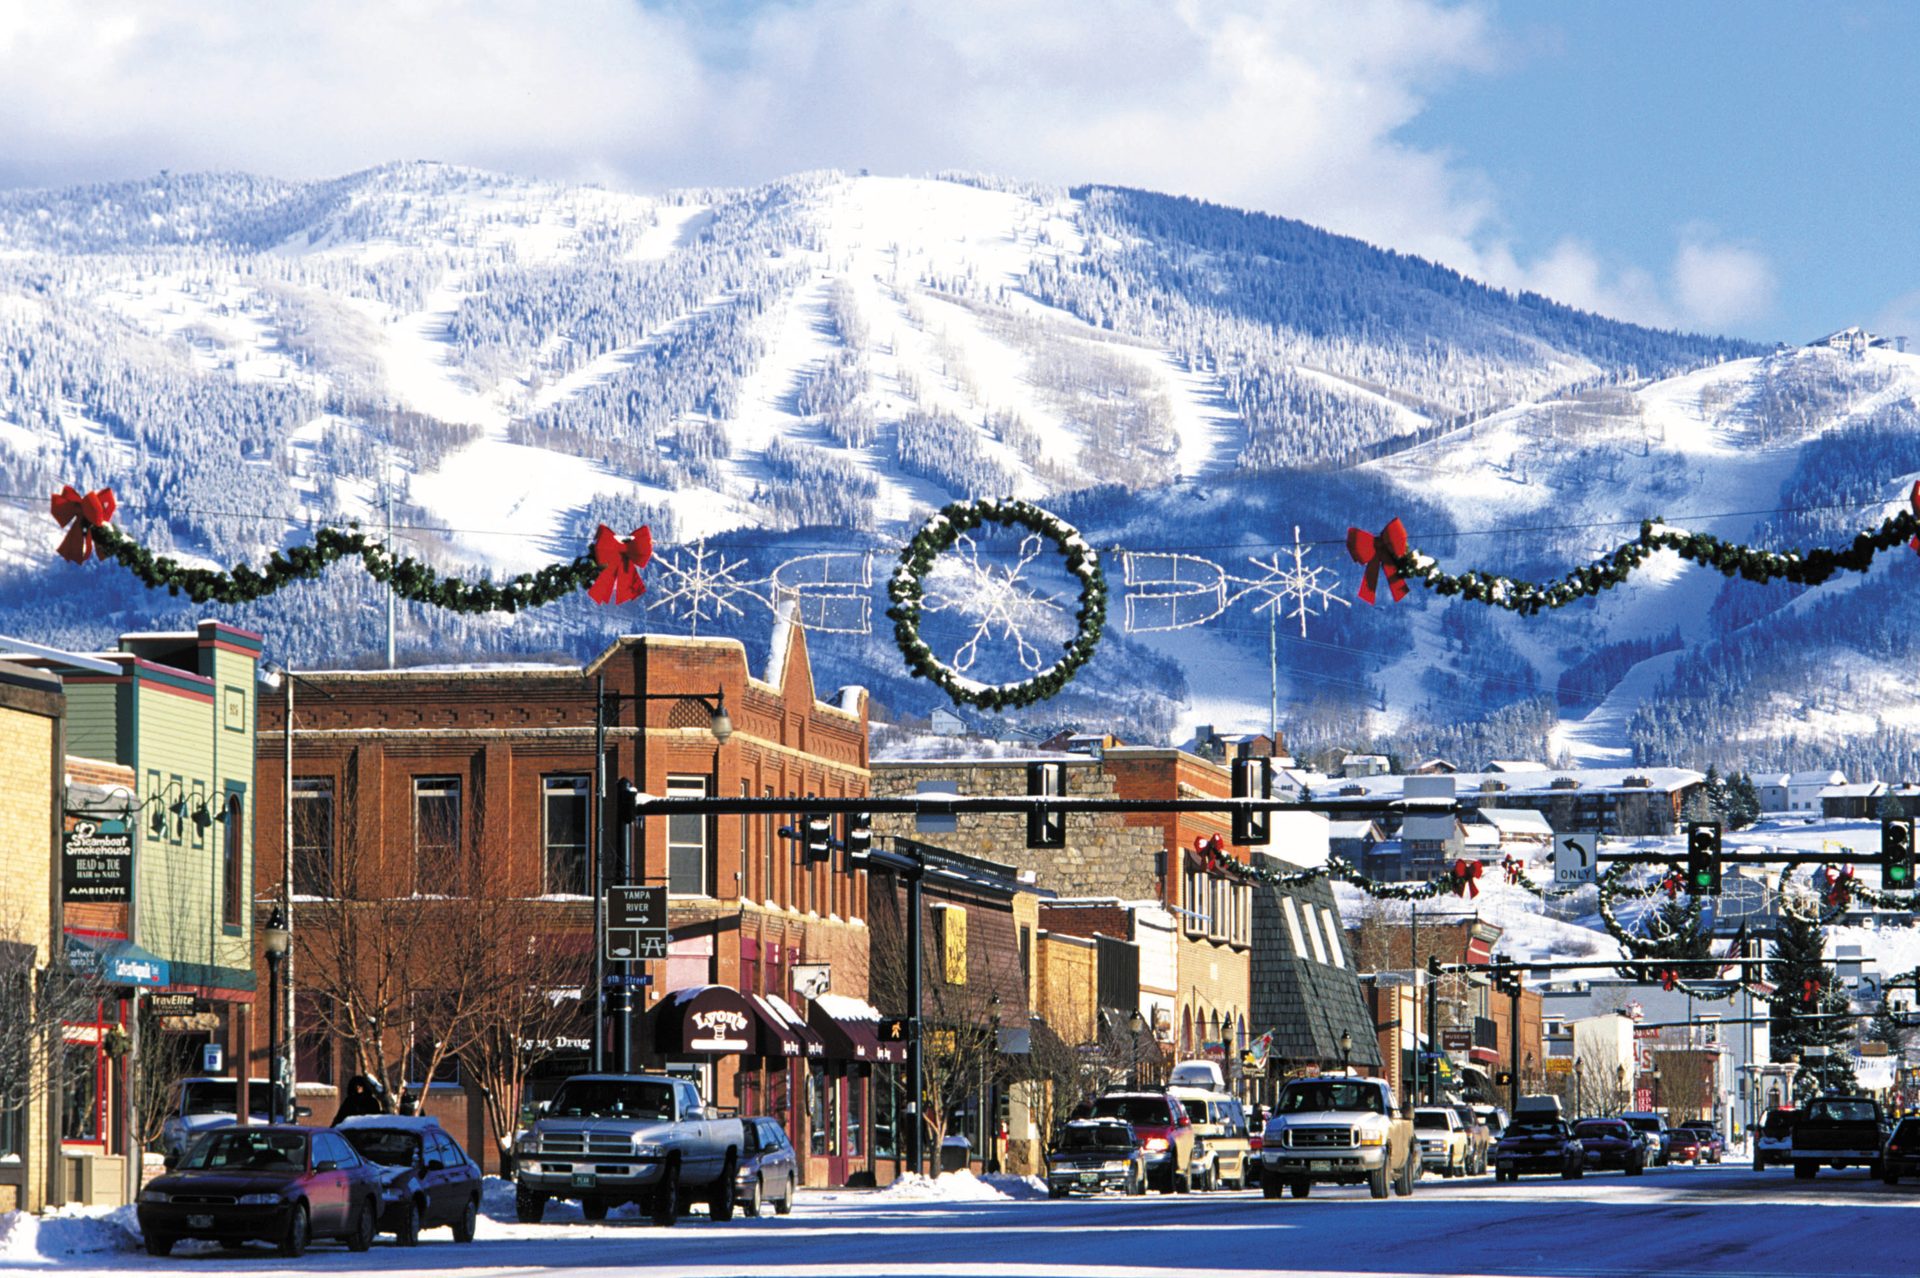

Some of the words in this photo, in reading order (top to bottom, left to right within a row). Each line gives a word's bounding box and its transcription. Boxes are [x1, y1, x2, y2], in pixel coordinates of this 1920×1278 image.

[71, 834, 128, 846] Steamboat
[66, 842, 131, 856] Smokehouse
[76, 859, 97, 871] HEAD
[98, 861, 105, 871] to
[106, 859, 120, 871] TOE
[1561, 869, 1591, 880] ONLY
[69, 887, 126, 895] AMBIENTE
[624, 891, 651, 900] YAMPA
[626, 903, 648, 912] RIVER
[625, 975, 647, 985] Street
[151, 995, 194, 1005] TravElite
[692, 1010, 748, 1031] Lyon's
[556, 1036, 591, 1050] Drug
